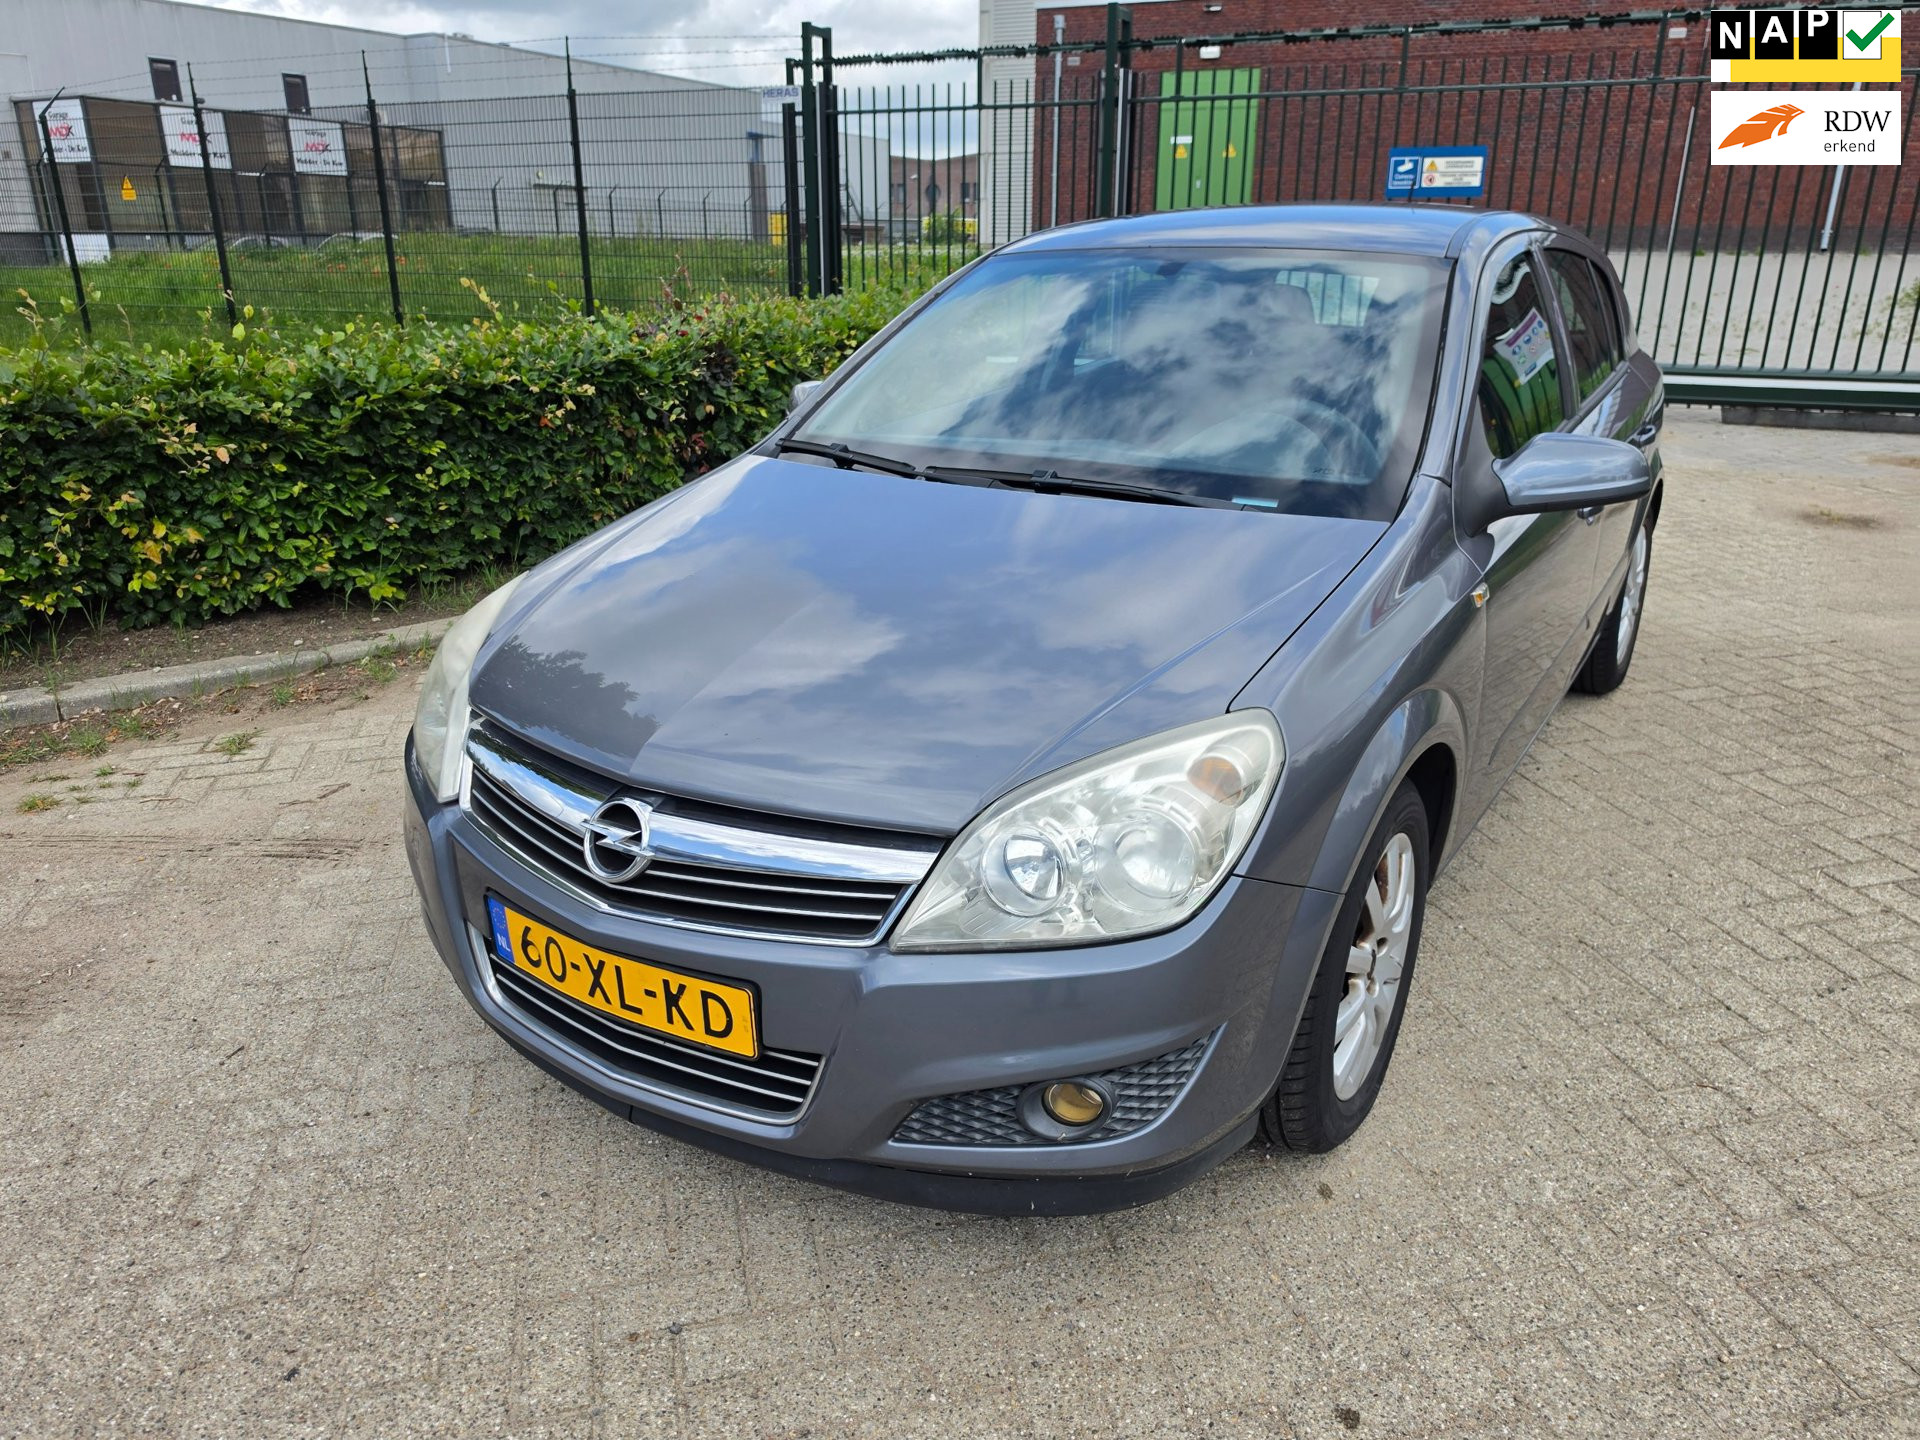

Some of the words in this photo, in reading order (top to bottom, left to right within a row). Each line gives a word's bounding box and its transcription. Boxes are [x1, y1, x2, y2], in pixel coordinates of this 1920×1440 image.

[762, 87, 799, 98] HERAS
[497, 932, 512, 952] NL
[520, 925, 734, 1039] 60-XL-KD
